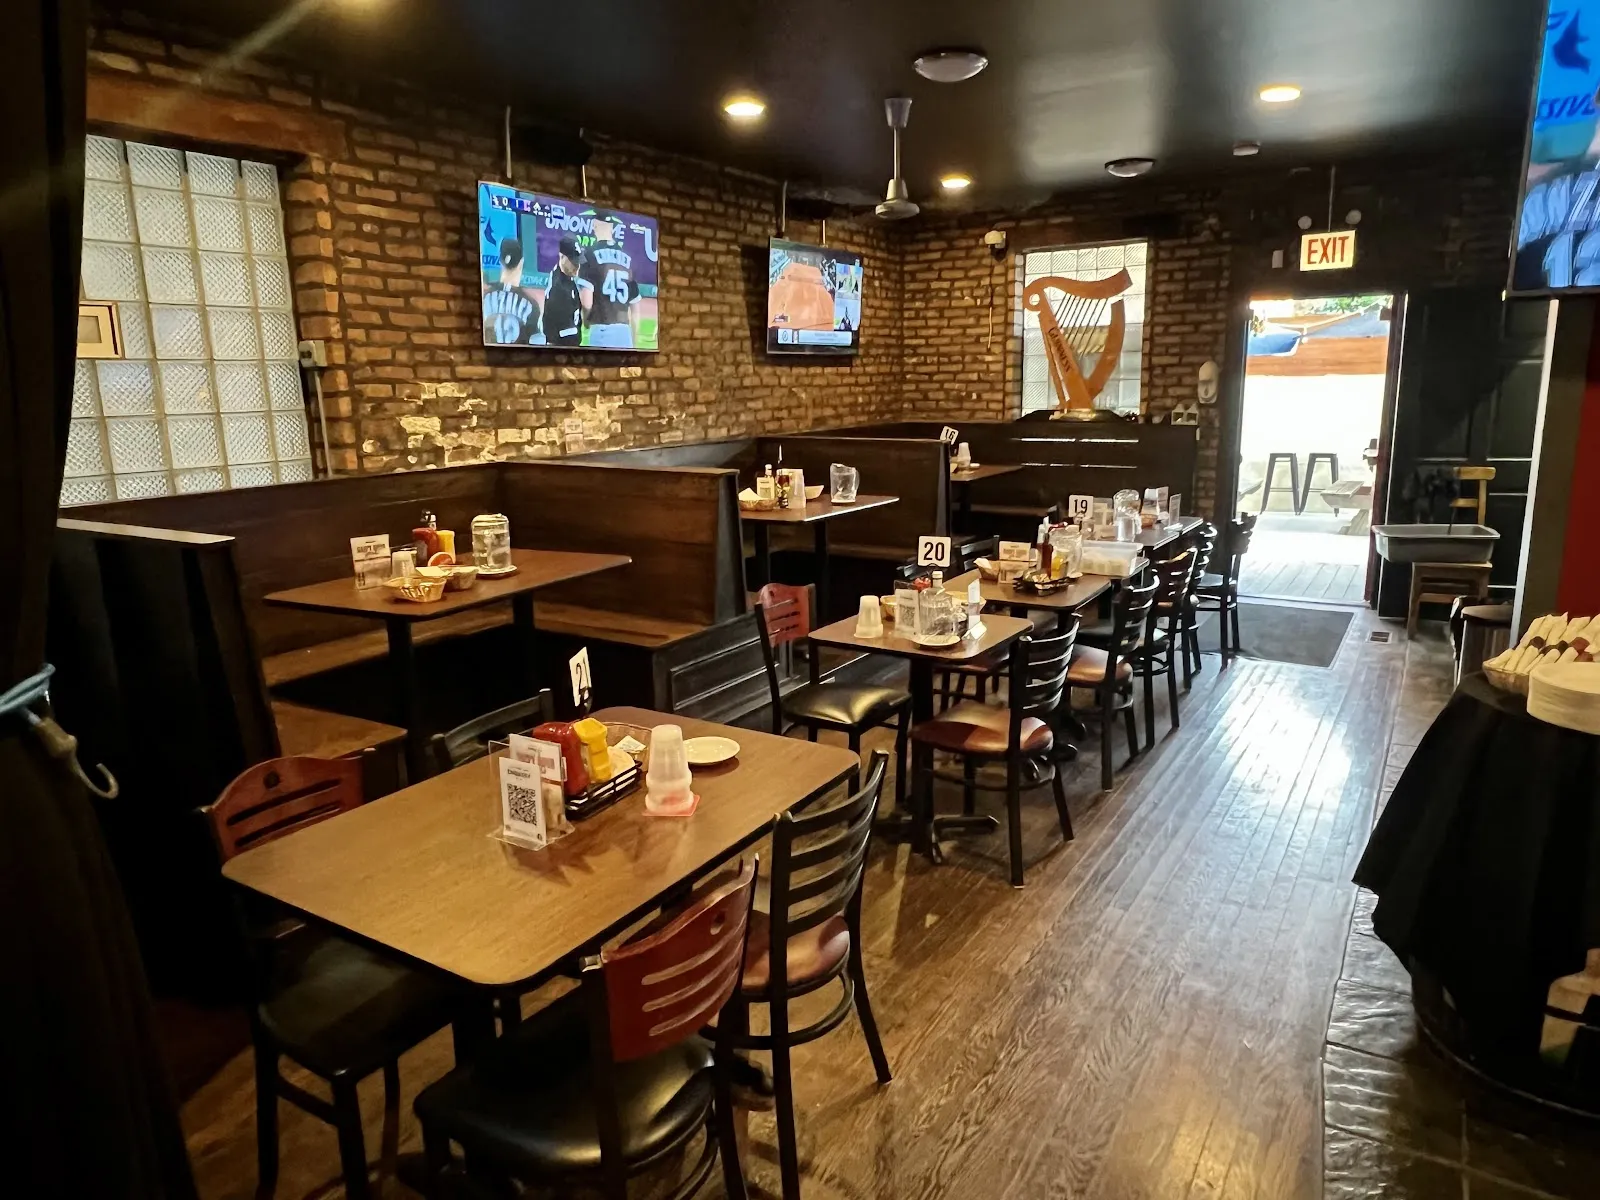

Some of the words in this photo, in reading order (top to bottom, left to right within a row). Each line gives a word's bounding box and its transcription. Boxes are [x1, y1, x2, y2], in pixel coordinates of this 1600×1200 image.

[1307, 235, 1350, 265] EXIT
[602, 269, 629, 305] 45
[945, 428, 956, 442] 16
[1073, 498, 1088, 515] 19
[923, 541, 945, 562] 20
[575, 657, 590, 696] 21
